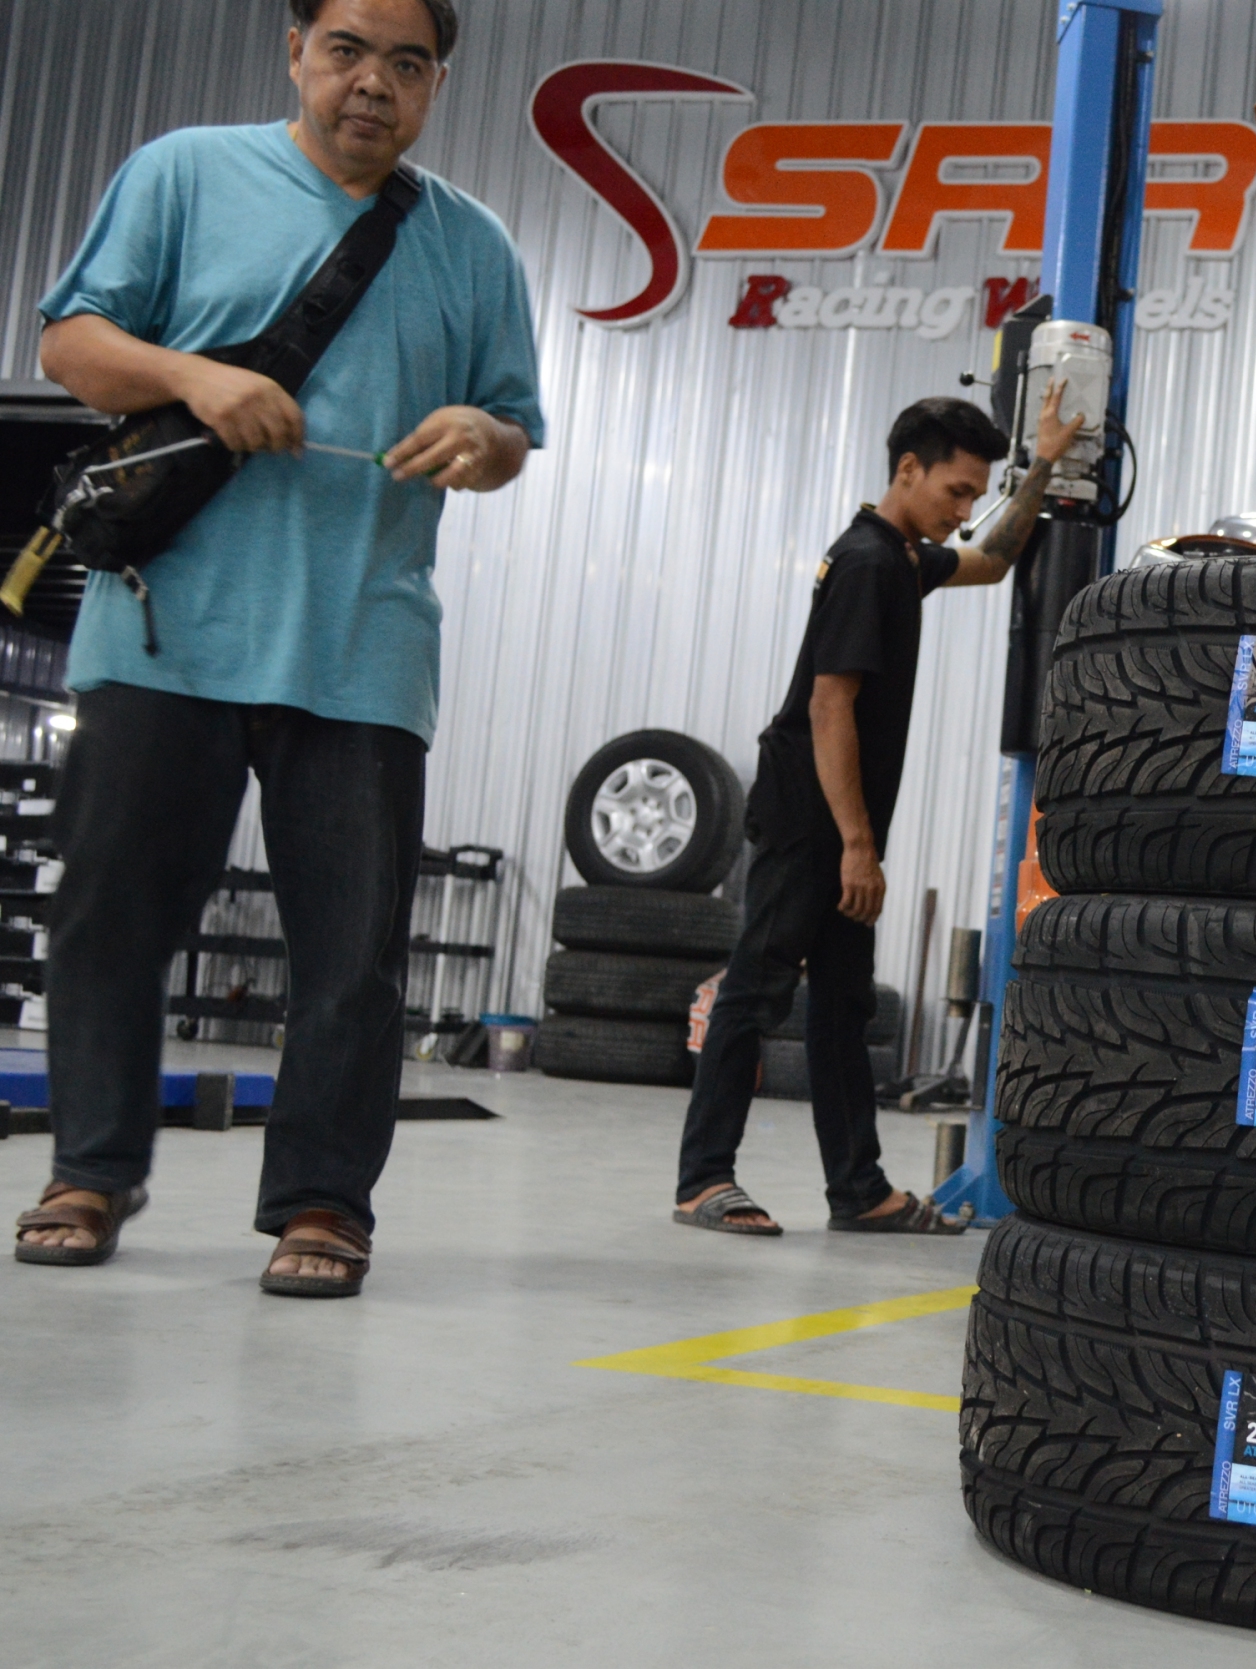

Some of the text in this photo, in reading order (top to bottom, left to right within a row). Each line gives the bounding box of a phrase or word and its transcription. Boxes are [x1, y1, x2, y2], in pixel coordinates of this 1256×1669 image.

[729, 272, 1234, 339] Racing Wels
[1229, 719, 1243, 769] ATREZZO
[1223, 1376, 1242, 1431] SVR LX
[1218, 1460, 1232, 1514] ATREZZO
